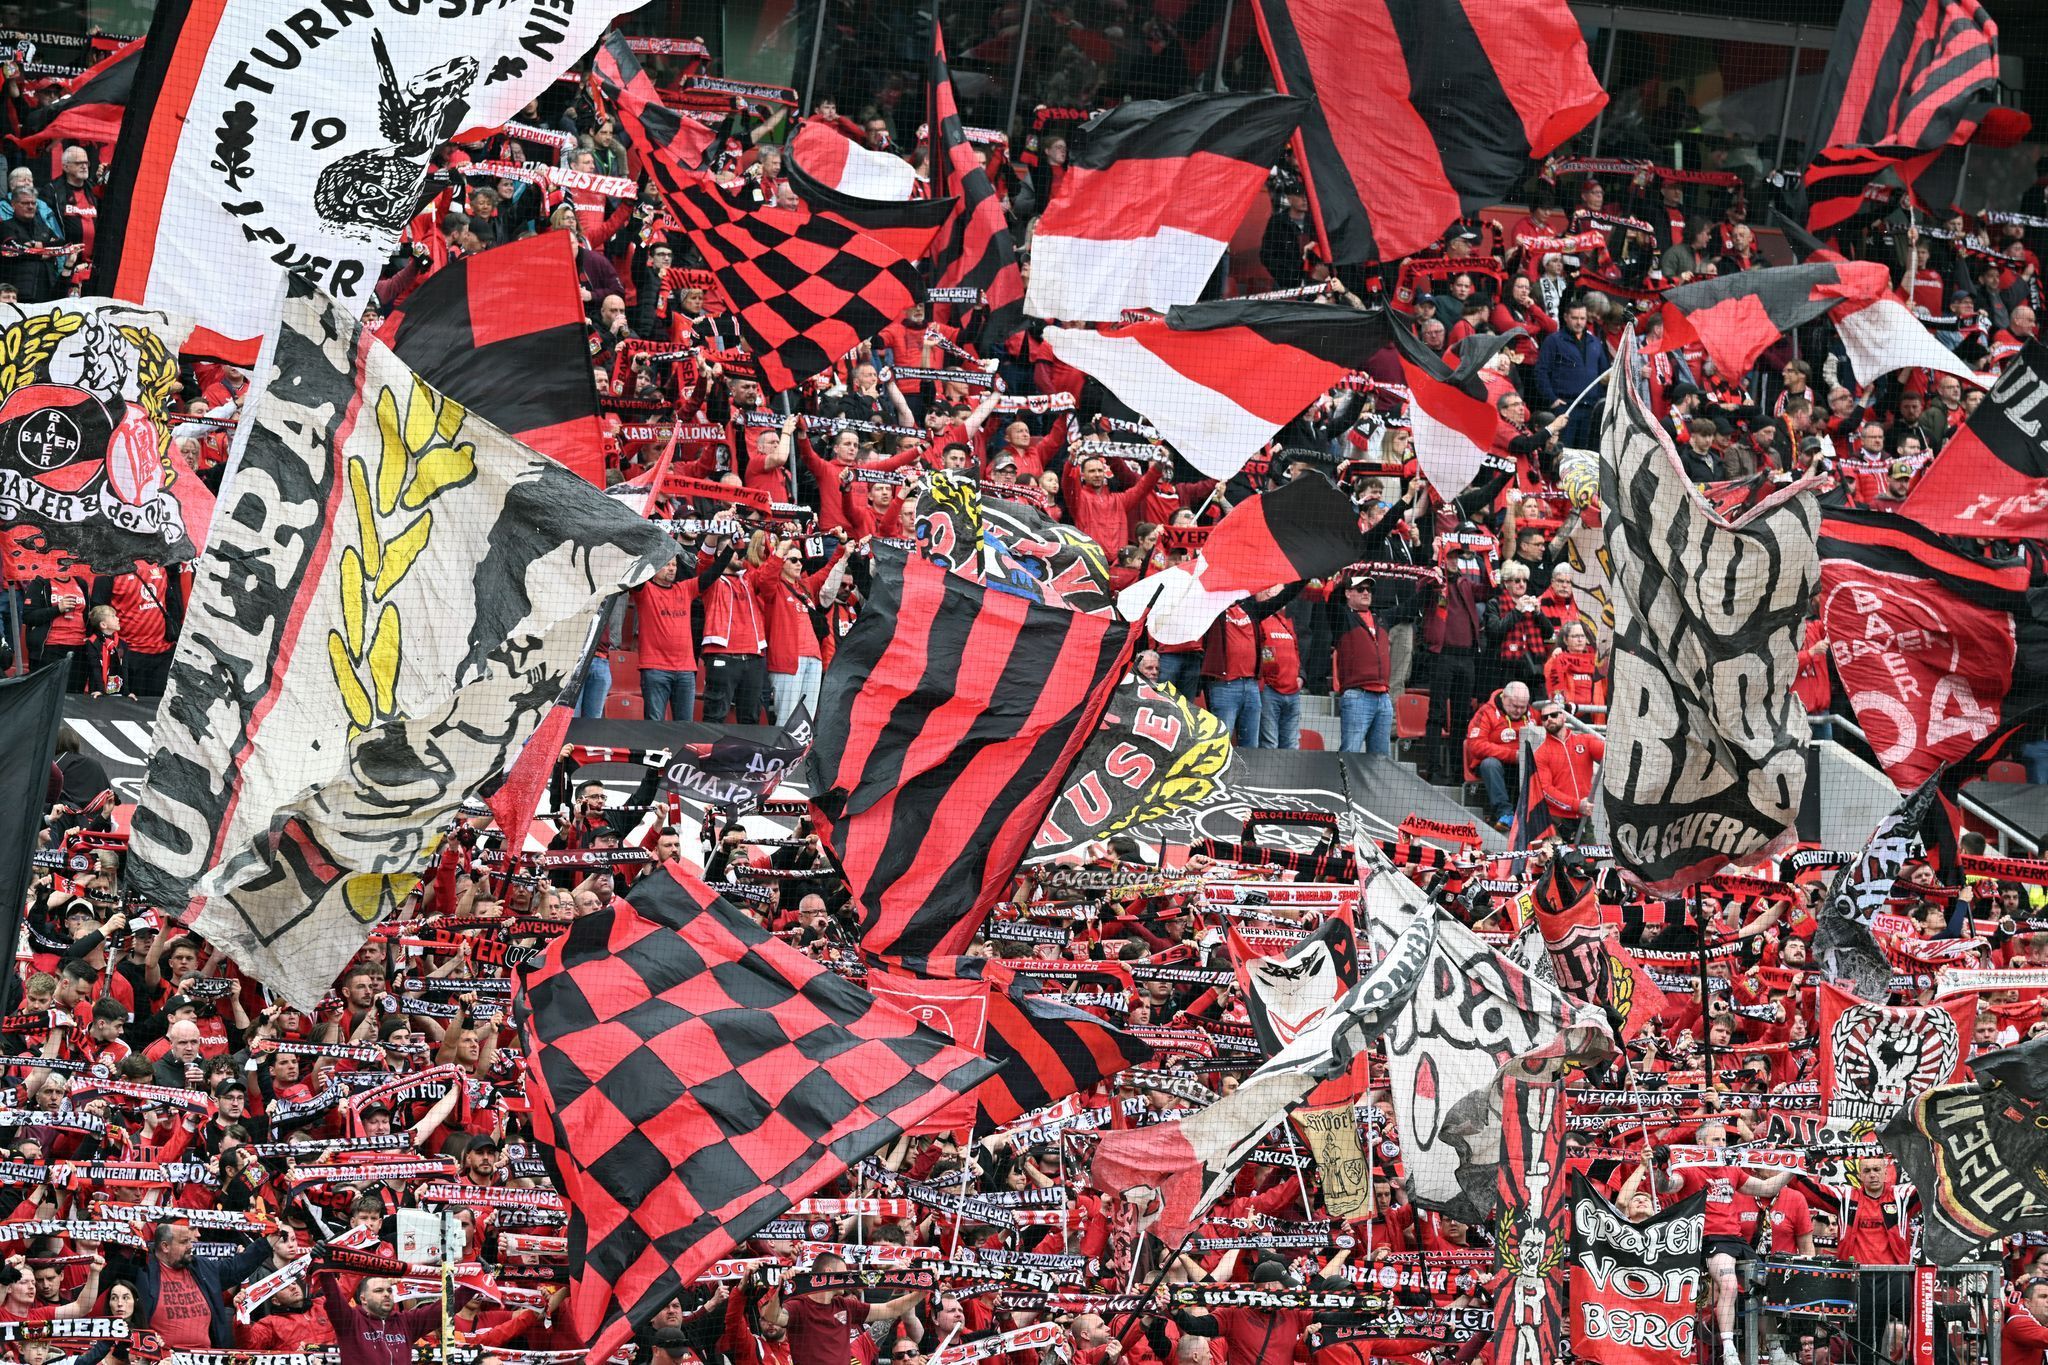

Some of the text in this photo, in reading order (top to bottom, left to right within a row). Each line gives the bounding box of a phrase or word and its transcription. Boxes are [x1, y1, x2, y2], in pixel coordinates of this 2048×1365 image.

[623, 426, 652, 440] XABI
[674, 477, 691, 490] für
[694, 481, 722, 494] Euch
[734, 486, 750, 499] Ihr
[752, 491, 769, 506] für
[1792, 851, 1834, 869] FREIHEIT
[1482, 880, 1520, 894] DANKE
[1030, 902, 1072, 918] NUR DER
[1625, 946, 1643, 960] DIE
[1645, 948, 1690, 962] MACHT
[1712, 942, 1745, 958] RHEIN
[1762, 971, 1779, 983] Wir
[321, 1043, 349, 1059] FÜR
[352, 1047, 381, 1063] LEV
[420, 1081, 447, 1099] FÜR
[171, 1096, 189, 1108] 2024
[93, 1167, 137, 1181] UNTERM
[464, 1185, 482, 1200] 04
[485, 1187, 564, 1208] LEVERKUSEN
[489, 1200, 518, 1209] MEISTER
[519, 1201, 538, 1211] 2024
[331, 1249, 405, 1273] LEVERKUSEN
[1579, 1251, 1702, 1304] Von
[1308, 1293, 1356, 1308] LEV
[51, 1317, 130, 1339] HERS
